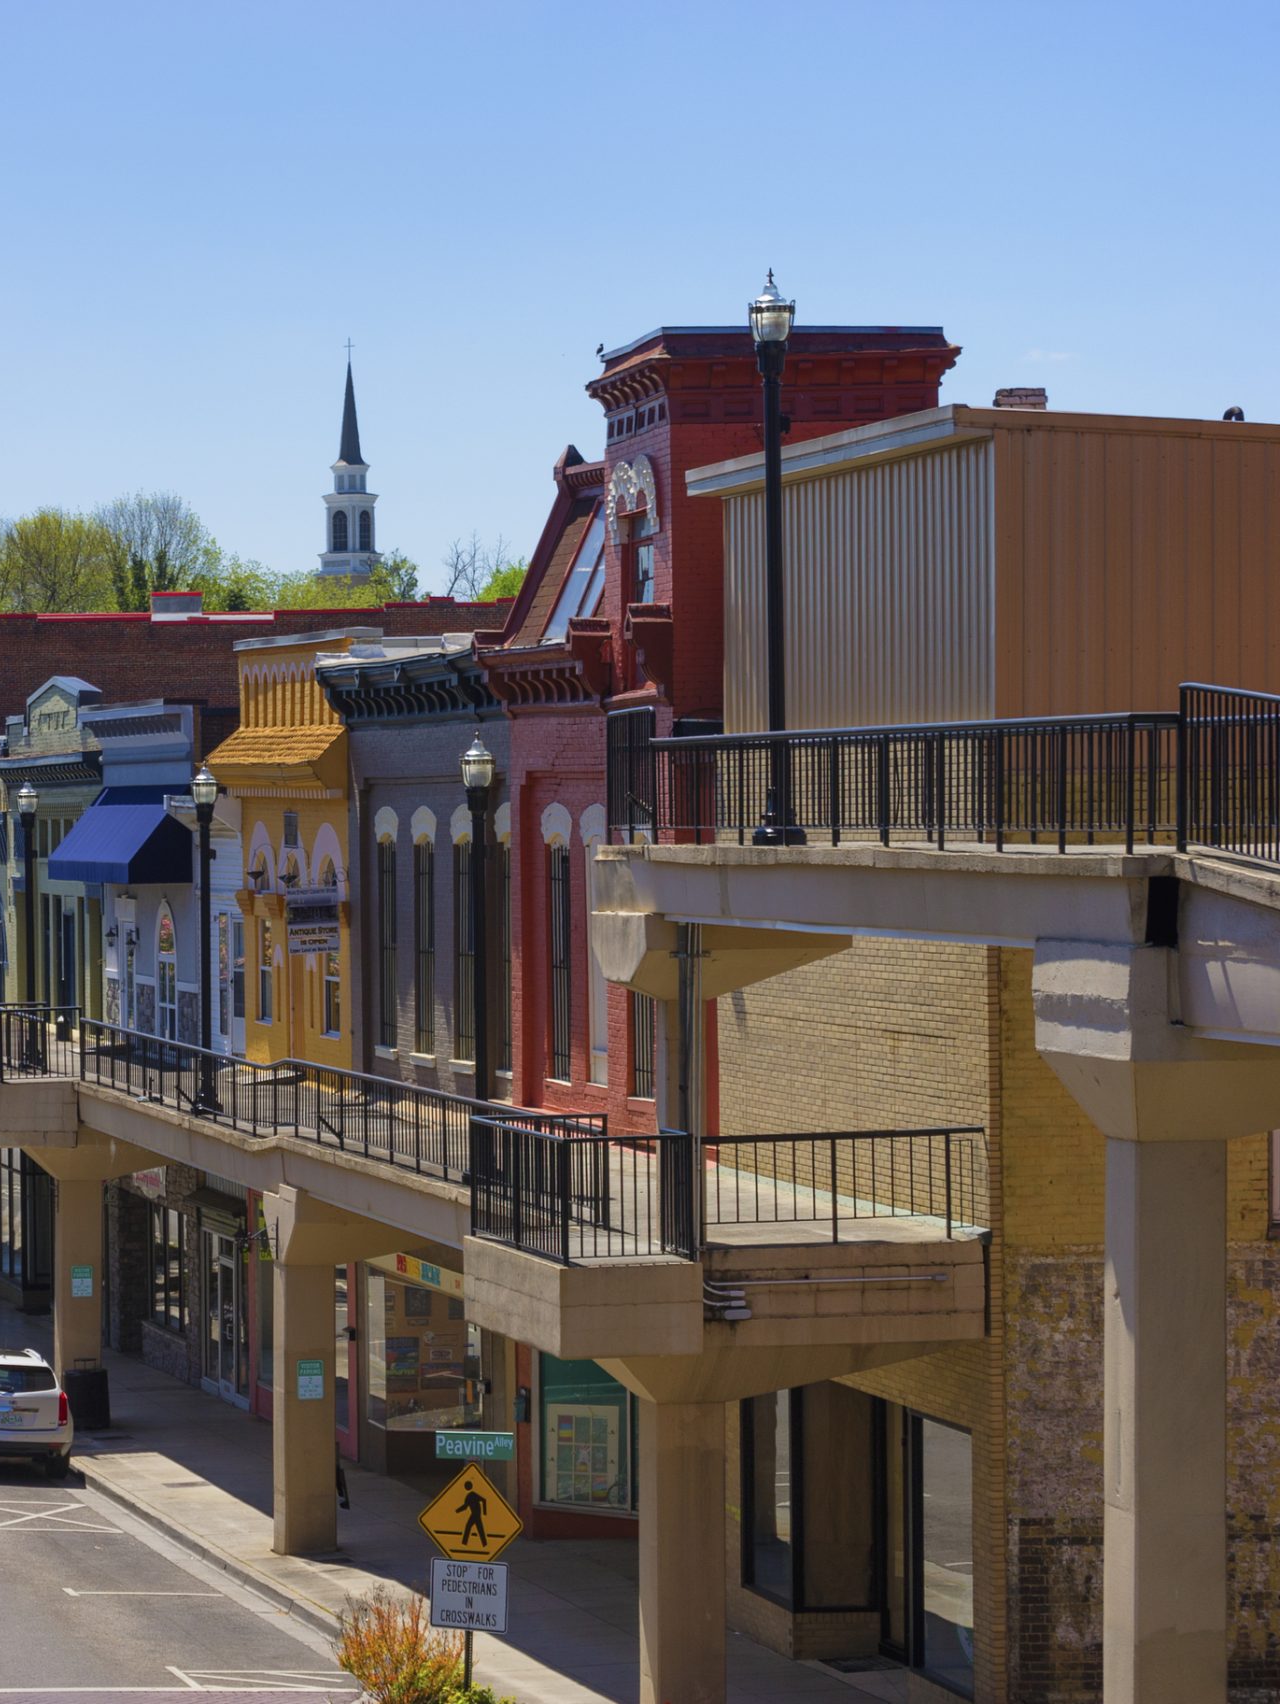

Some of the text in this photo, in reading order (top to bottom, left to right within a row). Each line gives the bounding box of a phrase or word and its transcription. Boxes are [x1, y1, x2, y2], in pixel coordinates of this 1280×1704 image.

[289, 926, 337, 936] ANTIQUE STORE
[436, 1435, 513, 1456] Peavine Alley
[446, 1564, 494, 1581] STOP FOR
[442, 1579, 497, 1597] PEDESTRIANS
[465, 1596, 473, 1609] IN
[440, 1609, 497, 1627] CROSSWALKS
